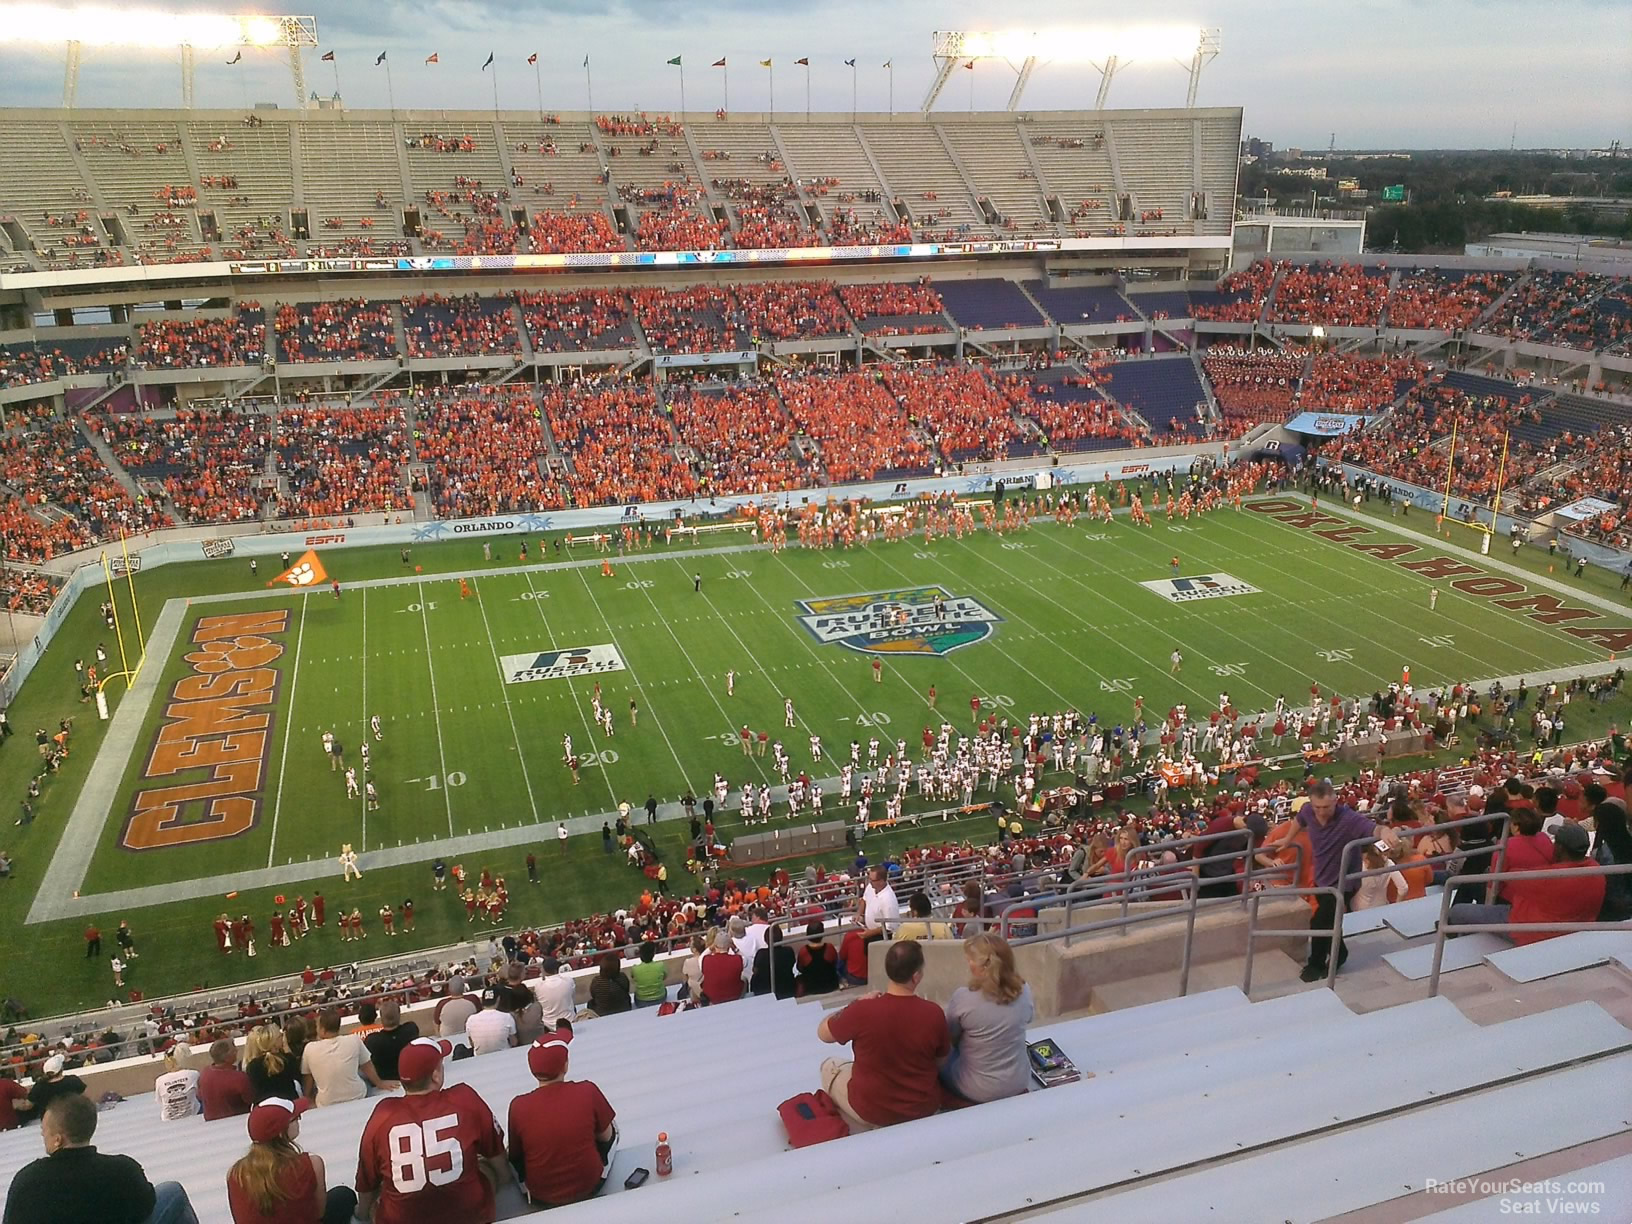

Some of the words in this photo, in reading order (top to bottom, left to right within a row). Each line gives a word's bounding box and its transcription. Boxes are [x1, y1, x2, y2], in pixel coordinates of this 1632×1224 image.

[1121, 464, 1149, 474] ESPN
[998, 475, 1033, 485] ORLAN
[453, 521, 515, 533] ORLANDO
[305, 534, 345, 546] ESPN
[1243, 500, 1632, 654] OKLAHOMA
[1171, 584, 1252, 598] RUSSELL
[826, 608, 984, 635] ATHEIC
[869, 622, 962, 640] BOWL
[1315, 649, 1354, 662] 20
[511, 665, 618, 682] ATHLETIC
[513, 660, 619, 678] RUSSELL
[1207, 663, 1246, 677] 30
[1100, 678, 1134, 693] 40
[978, 694, 1016, 710] 50
[855, 711, 892, 728] 40
[579, 749, 620, 768] 20
[424, 771, 468, 791] 10
[388, 1112, 464, 1194] 85
